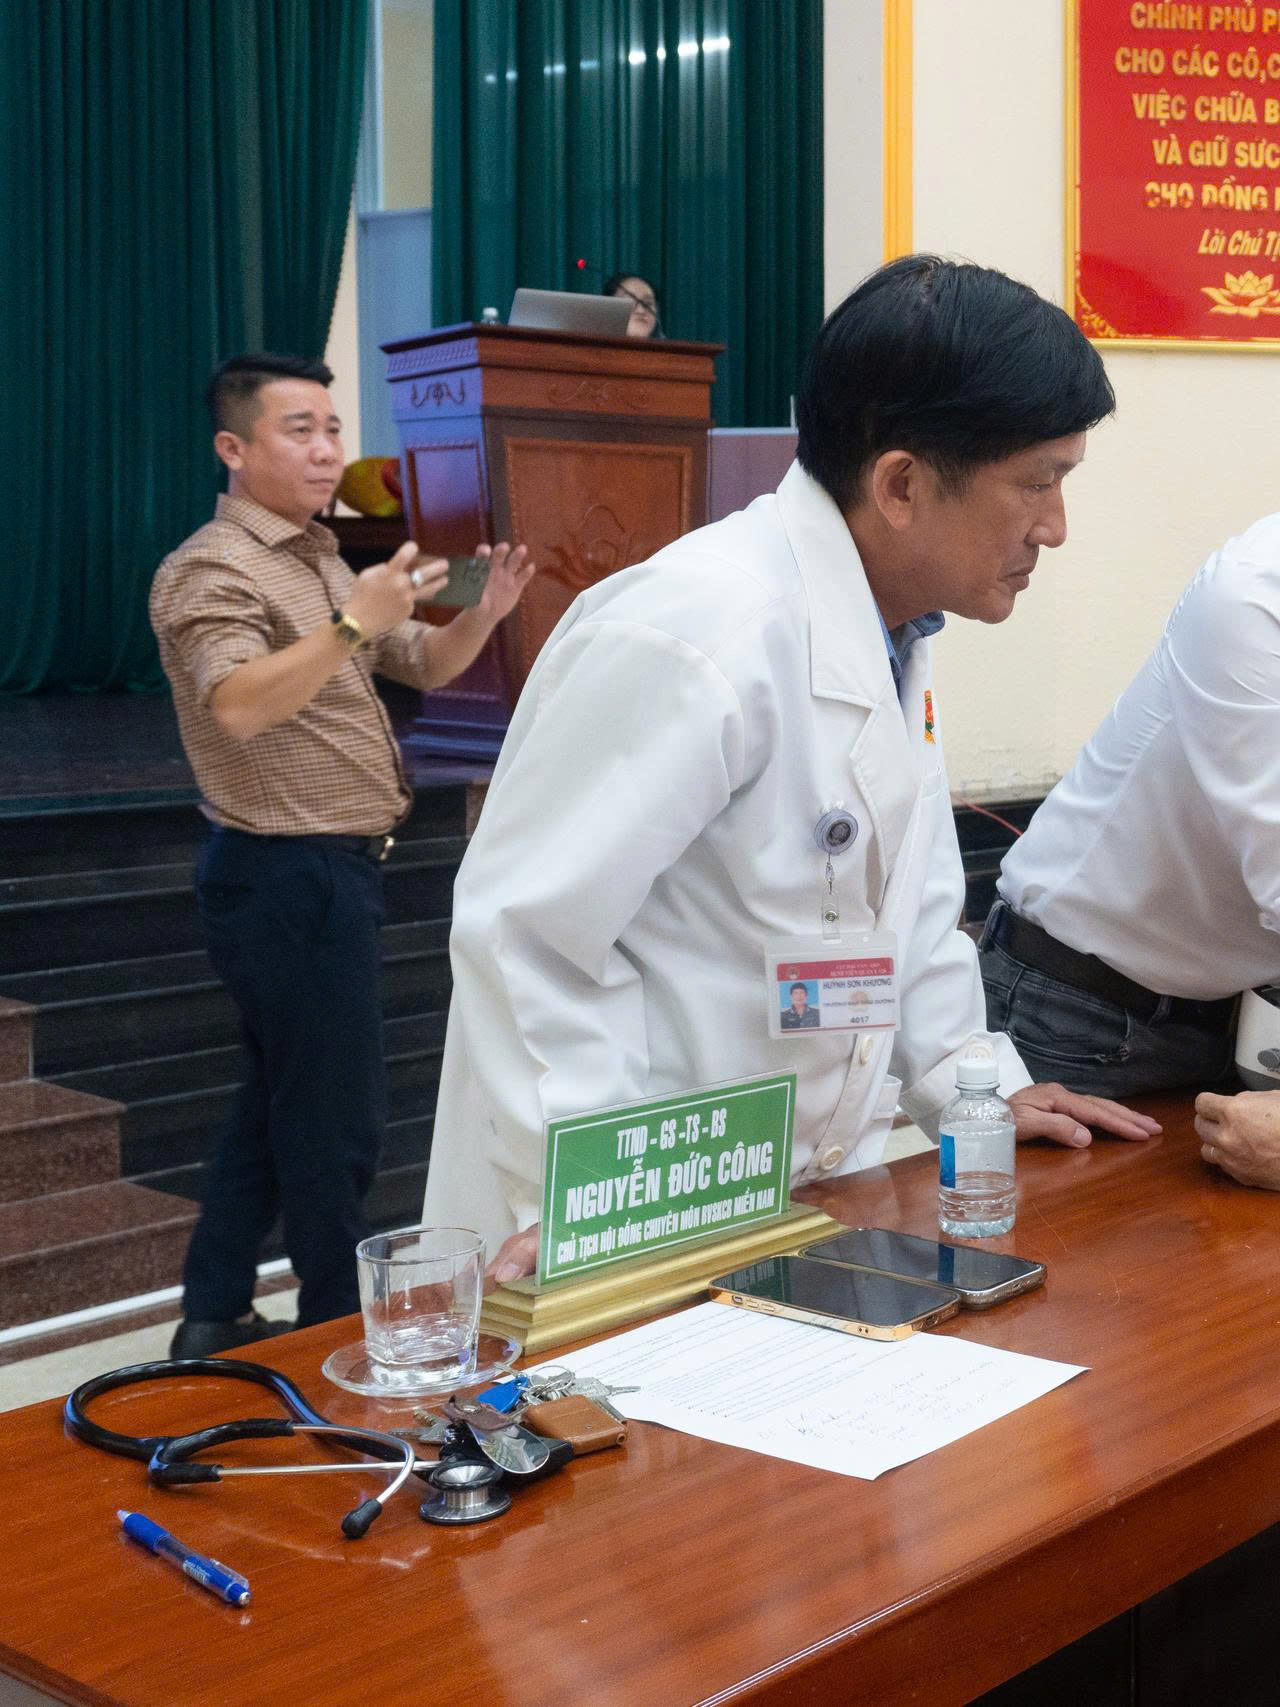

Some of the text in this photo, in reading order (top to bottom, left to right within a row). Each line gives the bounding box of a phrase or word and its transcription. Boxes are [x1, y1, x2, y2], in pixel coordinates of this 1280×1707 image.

[1115, 47, 1166, 75] CHO
[1172, 44, 1219, 77] CÁC
[1132, 88, 1187, 127] VIỆC
[1195, 90, 1258, 123] CHỮA
[1152, 133, 1183, 165] VÀ
[1189, 135, 1230, 167] GIỮ
[1235, 137, 1280, 169] SỨC
[1228, 228, 1264, 257] Chủ
[616, 1125, 648, 1160] TTND
[660, 1118, 677, 1150] GS
[711, 1107, 727, 1139] BS
[565, 1141, 774, 1224] NGUYỄN ĐỨC CÔNG
[557, 1232, 577, 1265] CHỦ
[579, 1233, 599, 1262] TỊCH
[600, 1226, 616, 1256] HỘI
[617, 1217, 642, 1248] ĐỒNG
[643, 1210, 679, 1241] CHUYÊN
[680, 1205, 701, 1231] MÔN
[733, 1186, 756, 1216] MIỀN
[756, 1187, 776, 1211] NAM
